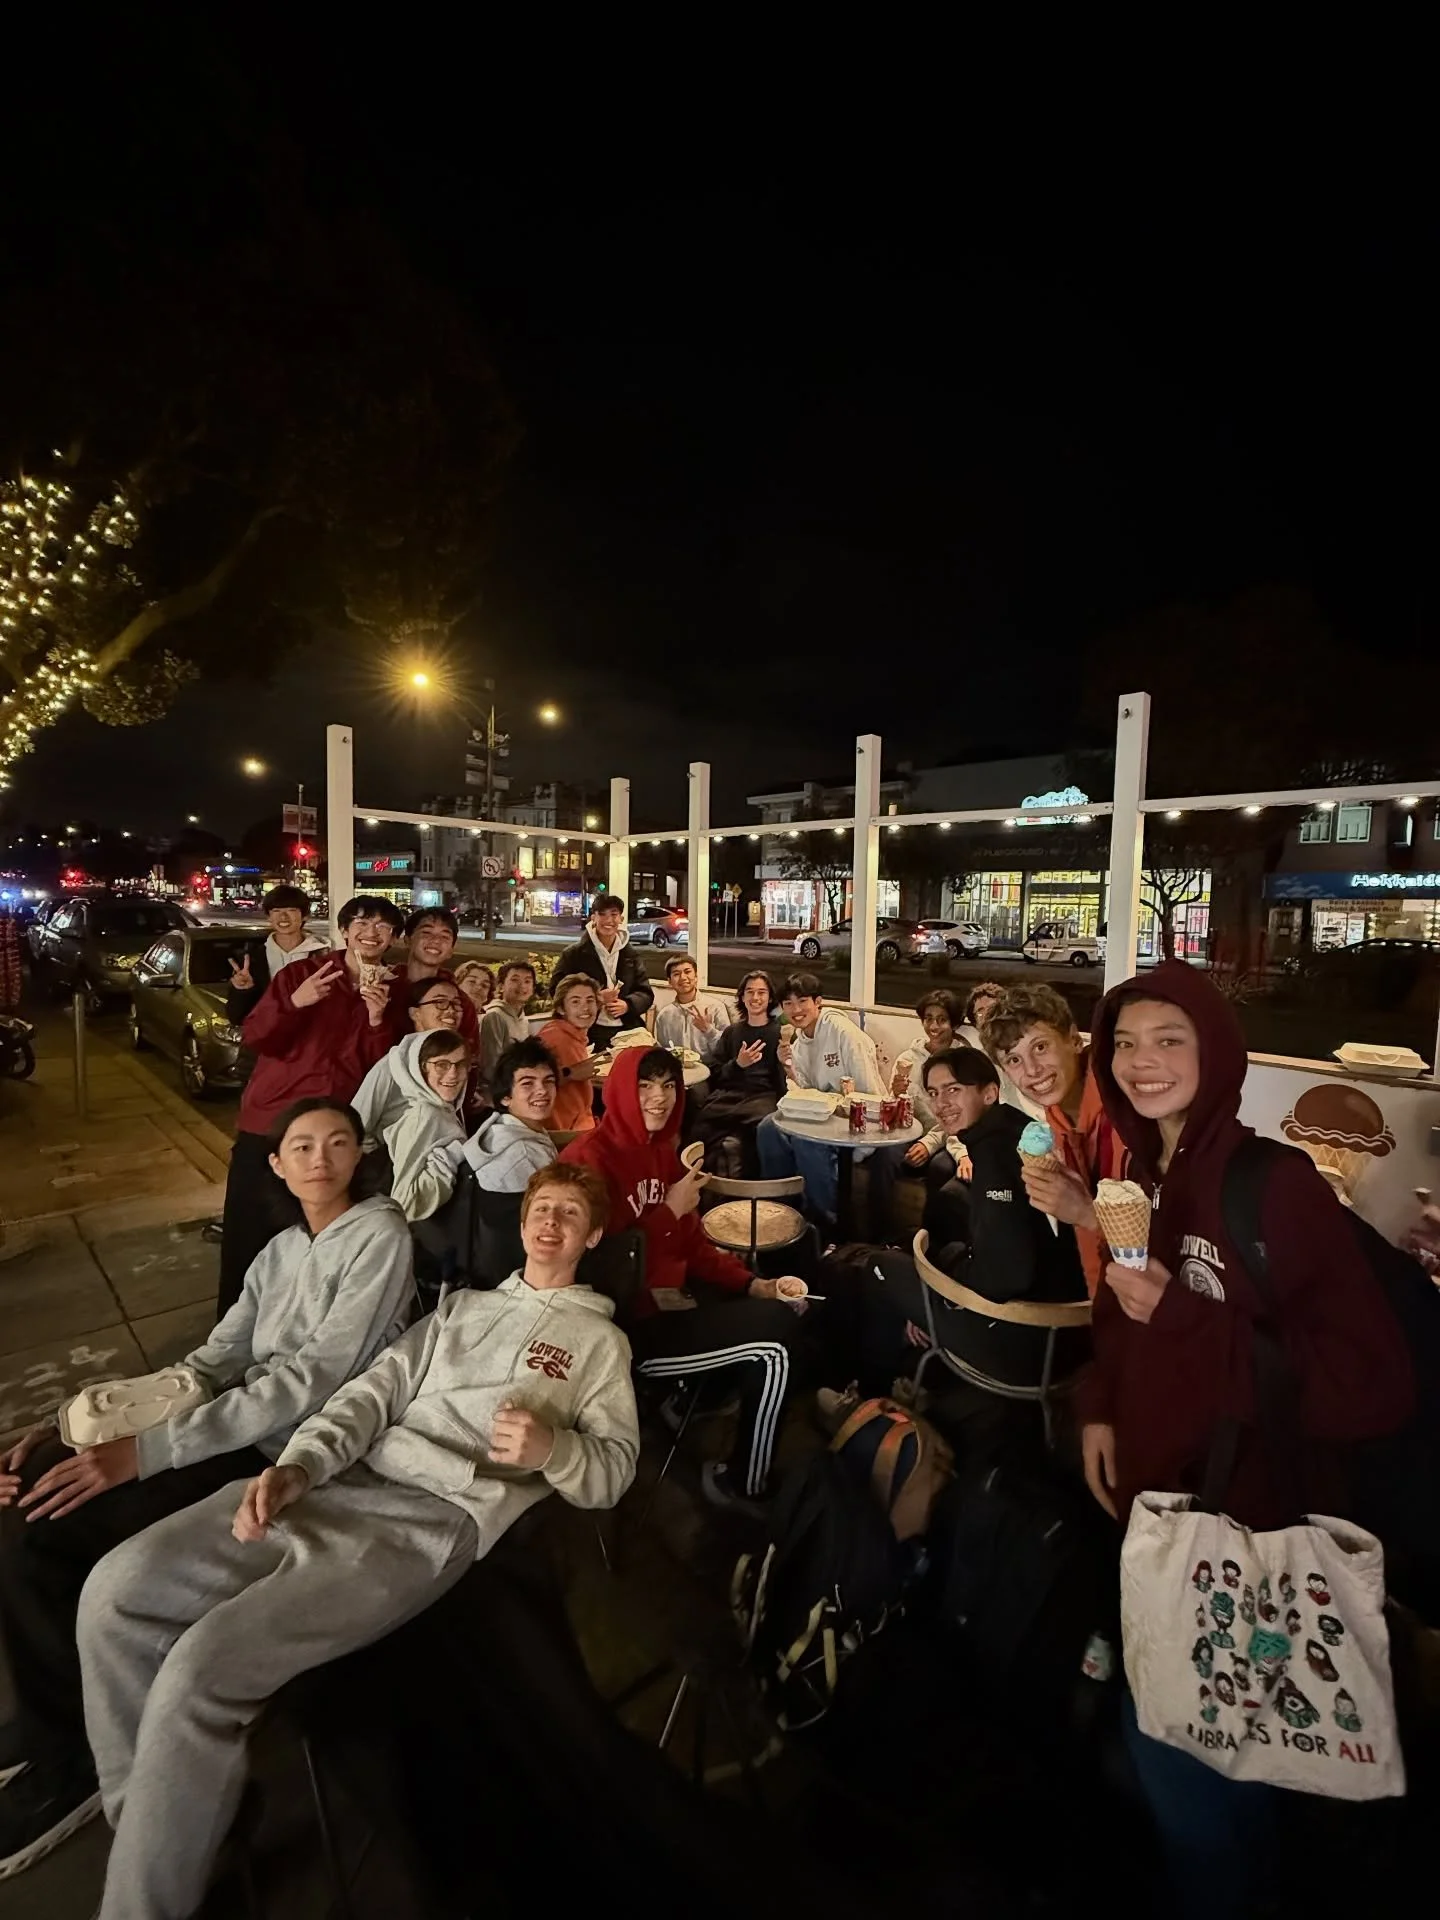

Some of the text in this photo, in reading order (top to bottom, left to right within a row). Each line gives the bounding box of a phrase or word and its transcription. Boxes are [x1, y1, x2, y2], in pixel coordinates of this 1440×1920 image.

[1180, 1234, 1225, 1270] OWELL
[528, 1340, 574, 1370] LOWELL
[1187, 1722, 1376, 1764] LIBRAES FOR ALL
